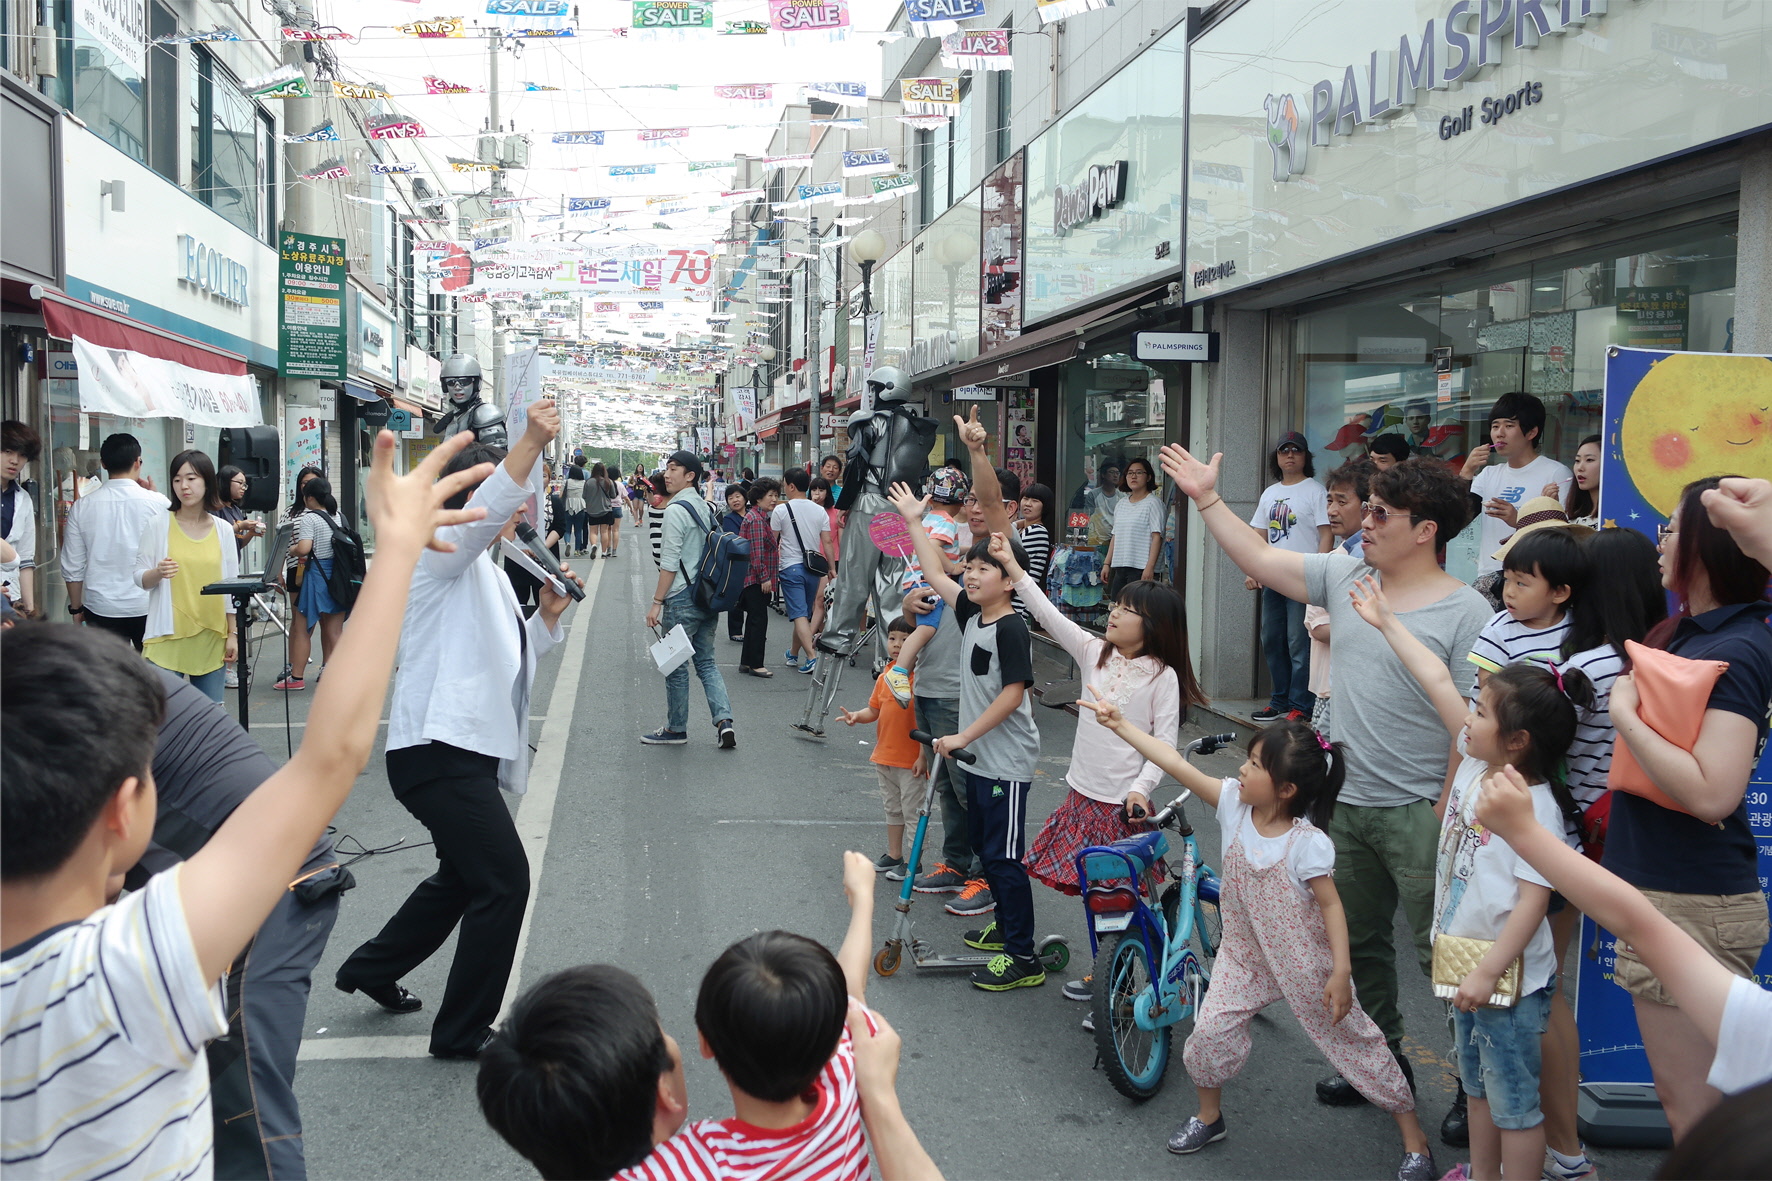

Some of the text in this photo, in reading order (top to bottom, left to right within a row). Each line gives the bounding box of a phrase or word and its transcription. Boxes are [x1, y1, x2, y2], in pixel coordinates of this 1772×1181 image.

[496, 0, 559, 14] SALE
[656, 1, 689, 9] POWER
[917, 0, 976, 18] SALE
[642, 7, 704, 26] SALE
[780, 6, 841, 28] SALE
[910, 83, 953, 101] SALE
[1439, 80, 1542, 141] Golf Sports
[850, 153, 885, 166] SALE
[616, 166, 651, 175] SALE
[804, 185, 834, 197] SALE
[879, 176, 910, 191] SALE
[1088, 160, 1120, 219] Paw
[574, 199, 605, 210] SALE
[282, 250, 344, 266] 노상유료주차장
[185, 234, 249, 307] ECOLIER
[295, 262, 330, 275] 이용안내
[556, 259, 663, 286] 그랜드세일
[668, 250, 711, 285] 70
[287, 279, 307, 287] 09:00
[319, 282, 338, 290] 20:00
[1152, 342, 1203, 351] PALMSPRINGS
[617, 372, 646, 380] 771-6767
